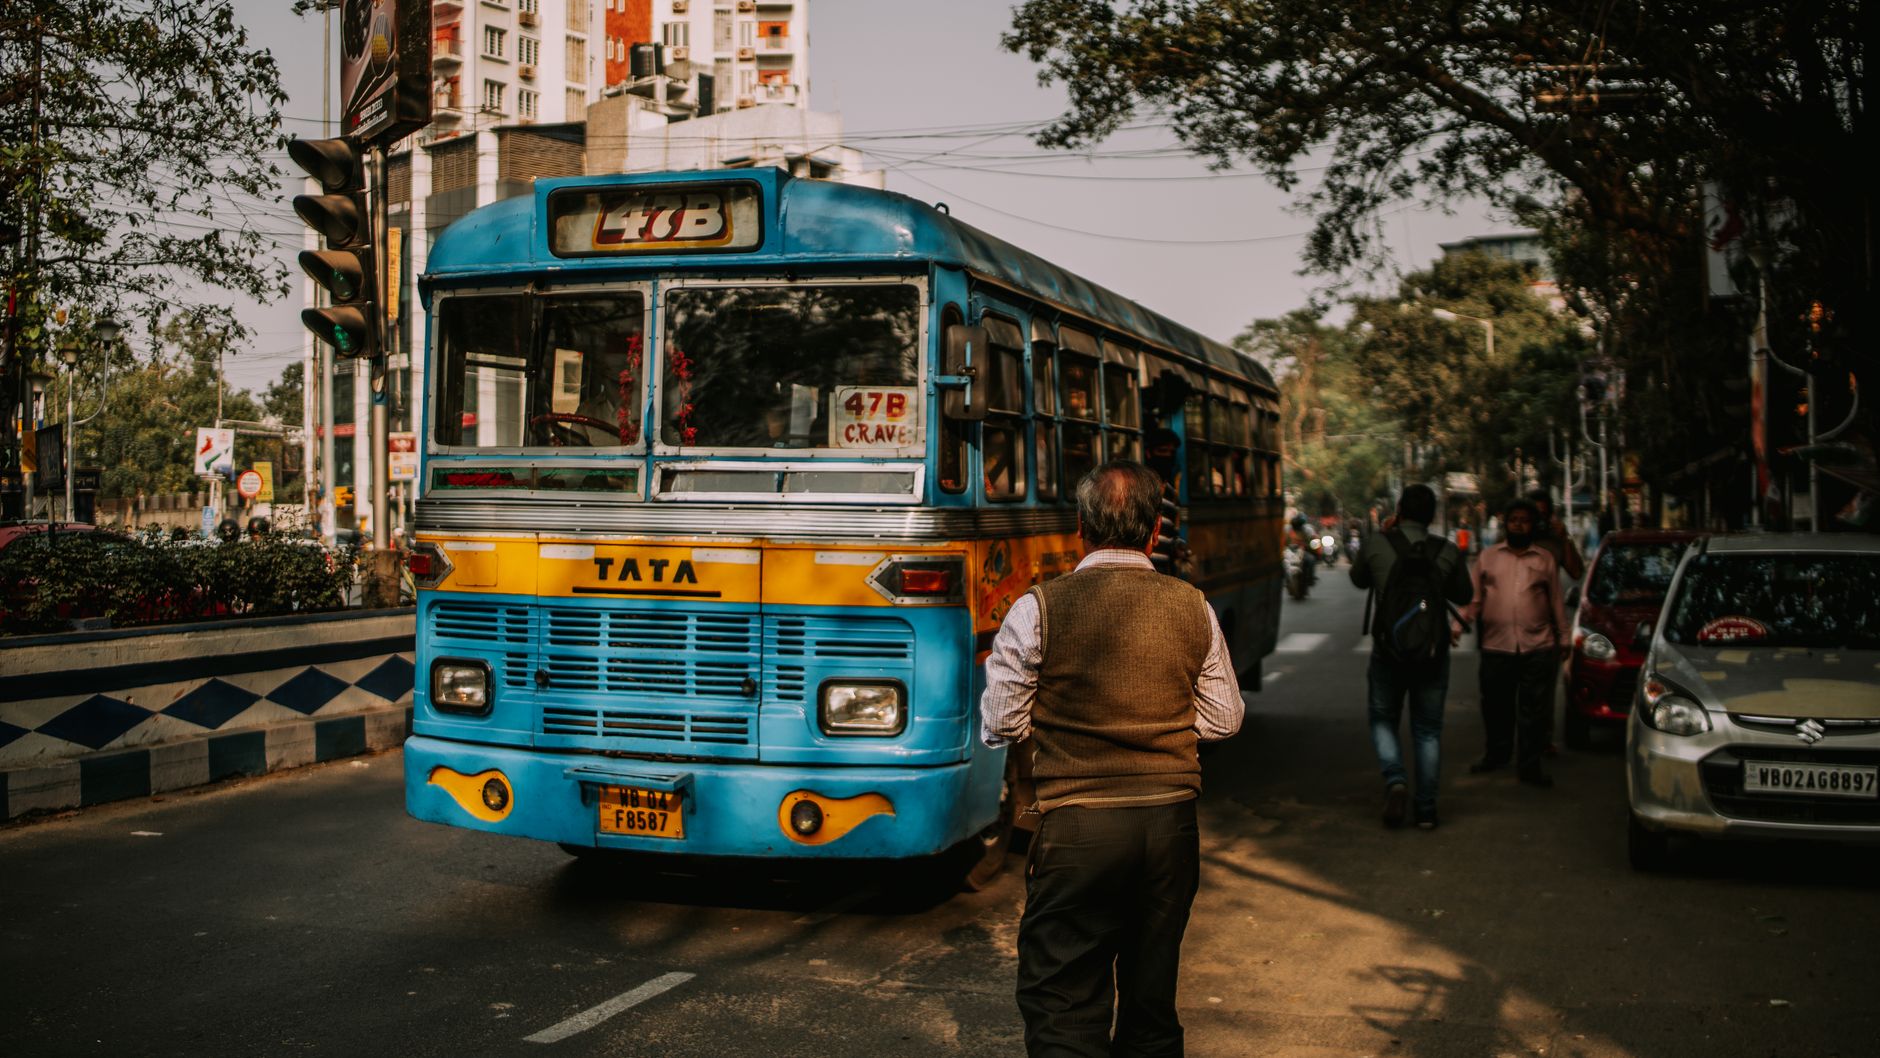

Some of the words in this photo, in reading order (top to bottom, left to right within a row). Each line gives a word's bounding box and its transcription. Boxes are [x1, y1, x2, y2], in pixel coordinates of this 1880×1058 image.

[602, 193, 723, 240] 47B
[844, 392, 906, 420] 47B
[594, 557, 698, 584] TATA
[1759, 767, 1875, 791] WB02AG8897
[620, 787, 640, 808] WB
[647, 790, 668, 809] 04
[616, 809, 668, 831] F8587
